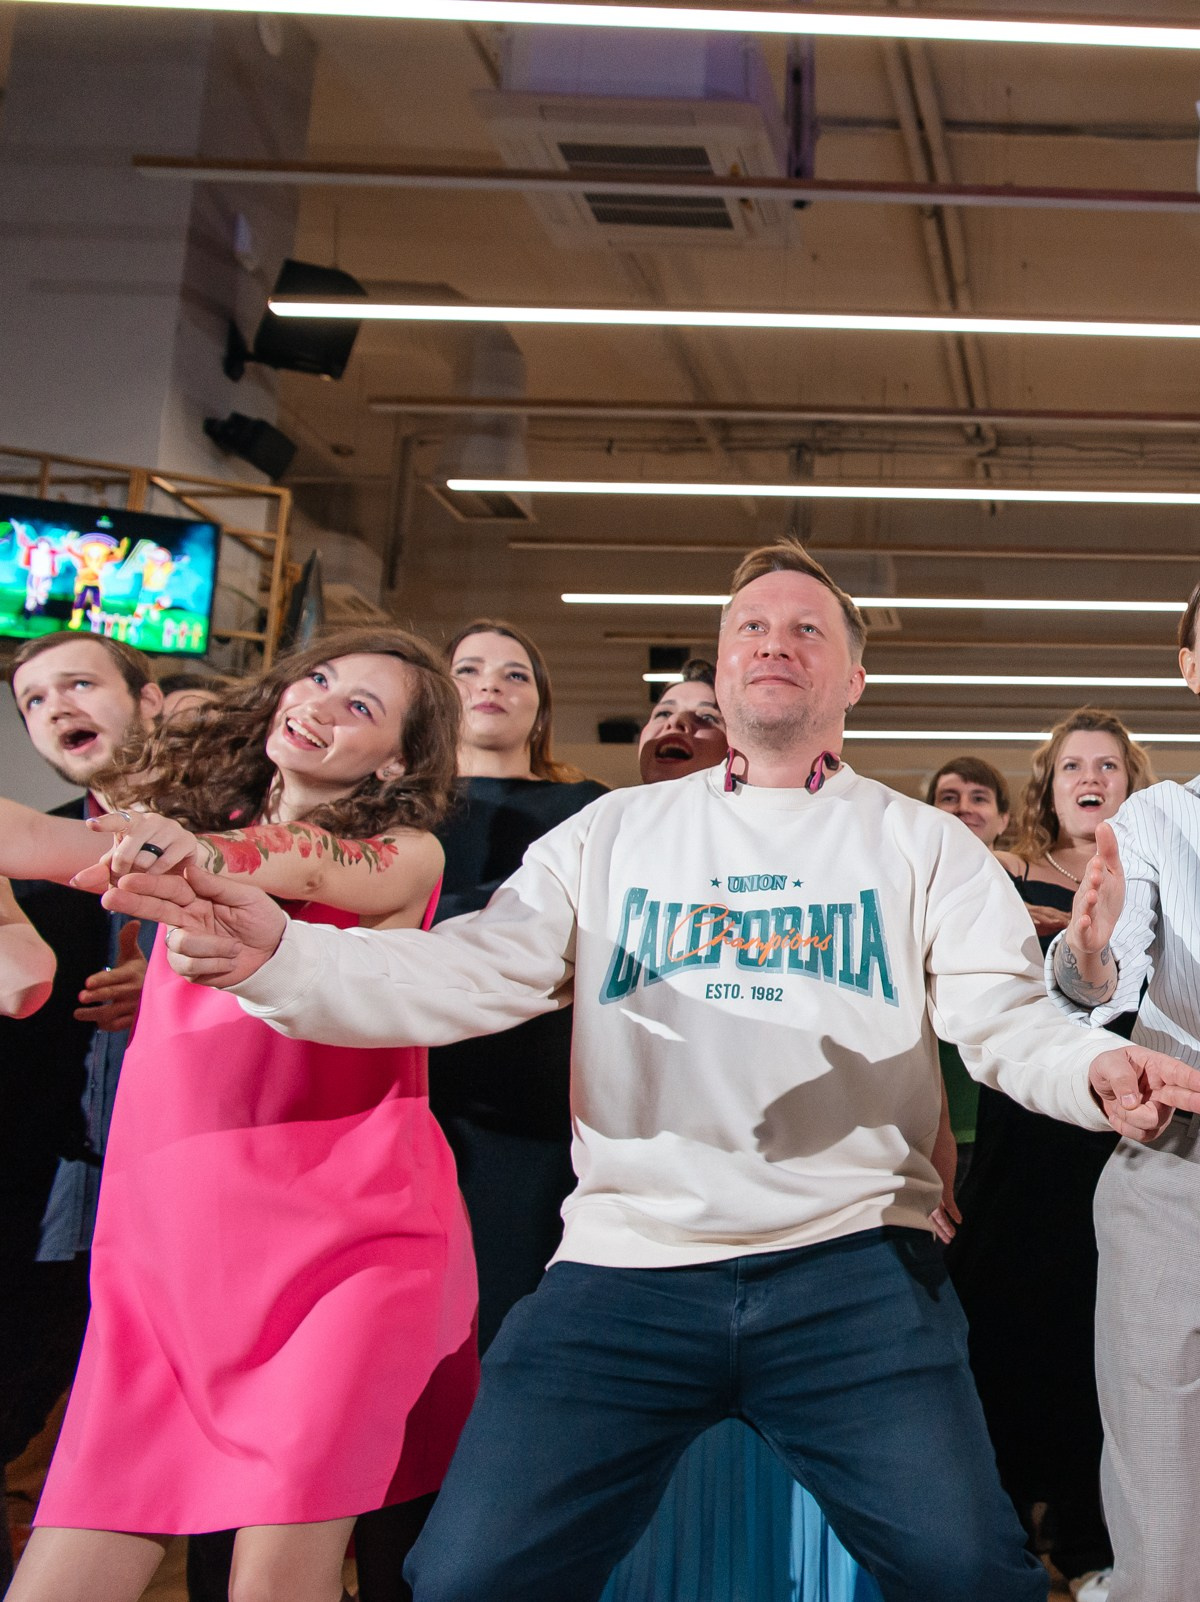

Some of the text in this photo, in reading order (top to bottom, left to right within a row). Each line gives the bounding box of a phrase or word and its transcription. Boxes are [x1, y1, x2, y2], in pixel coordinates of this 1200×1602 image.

[728, 874, 787, 893] UNION
[599, 887, 900, 1008] CALIFORNIA
[667, 903, 833, 966] Champions
[750, 985, 784, 1002] 1982
